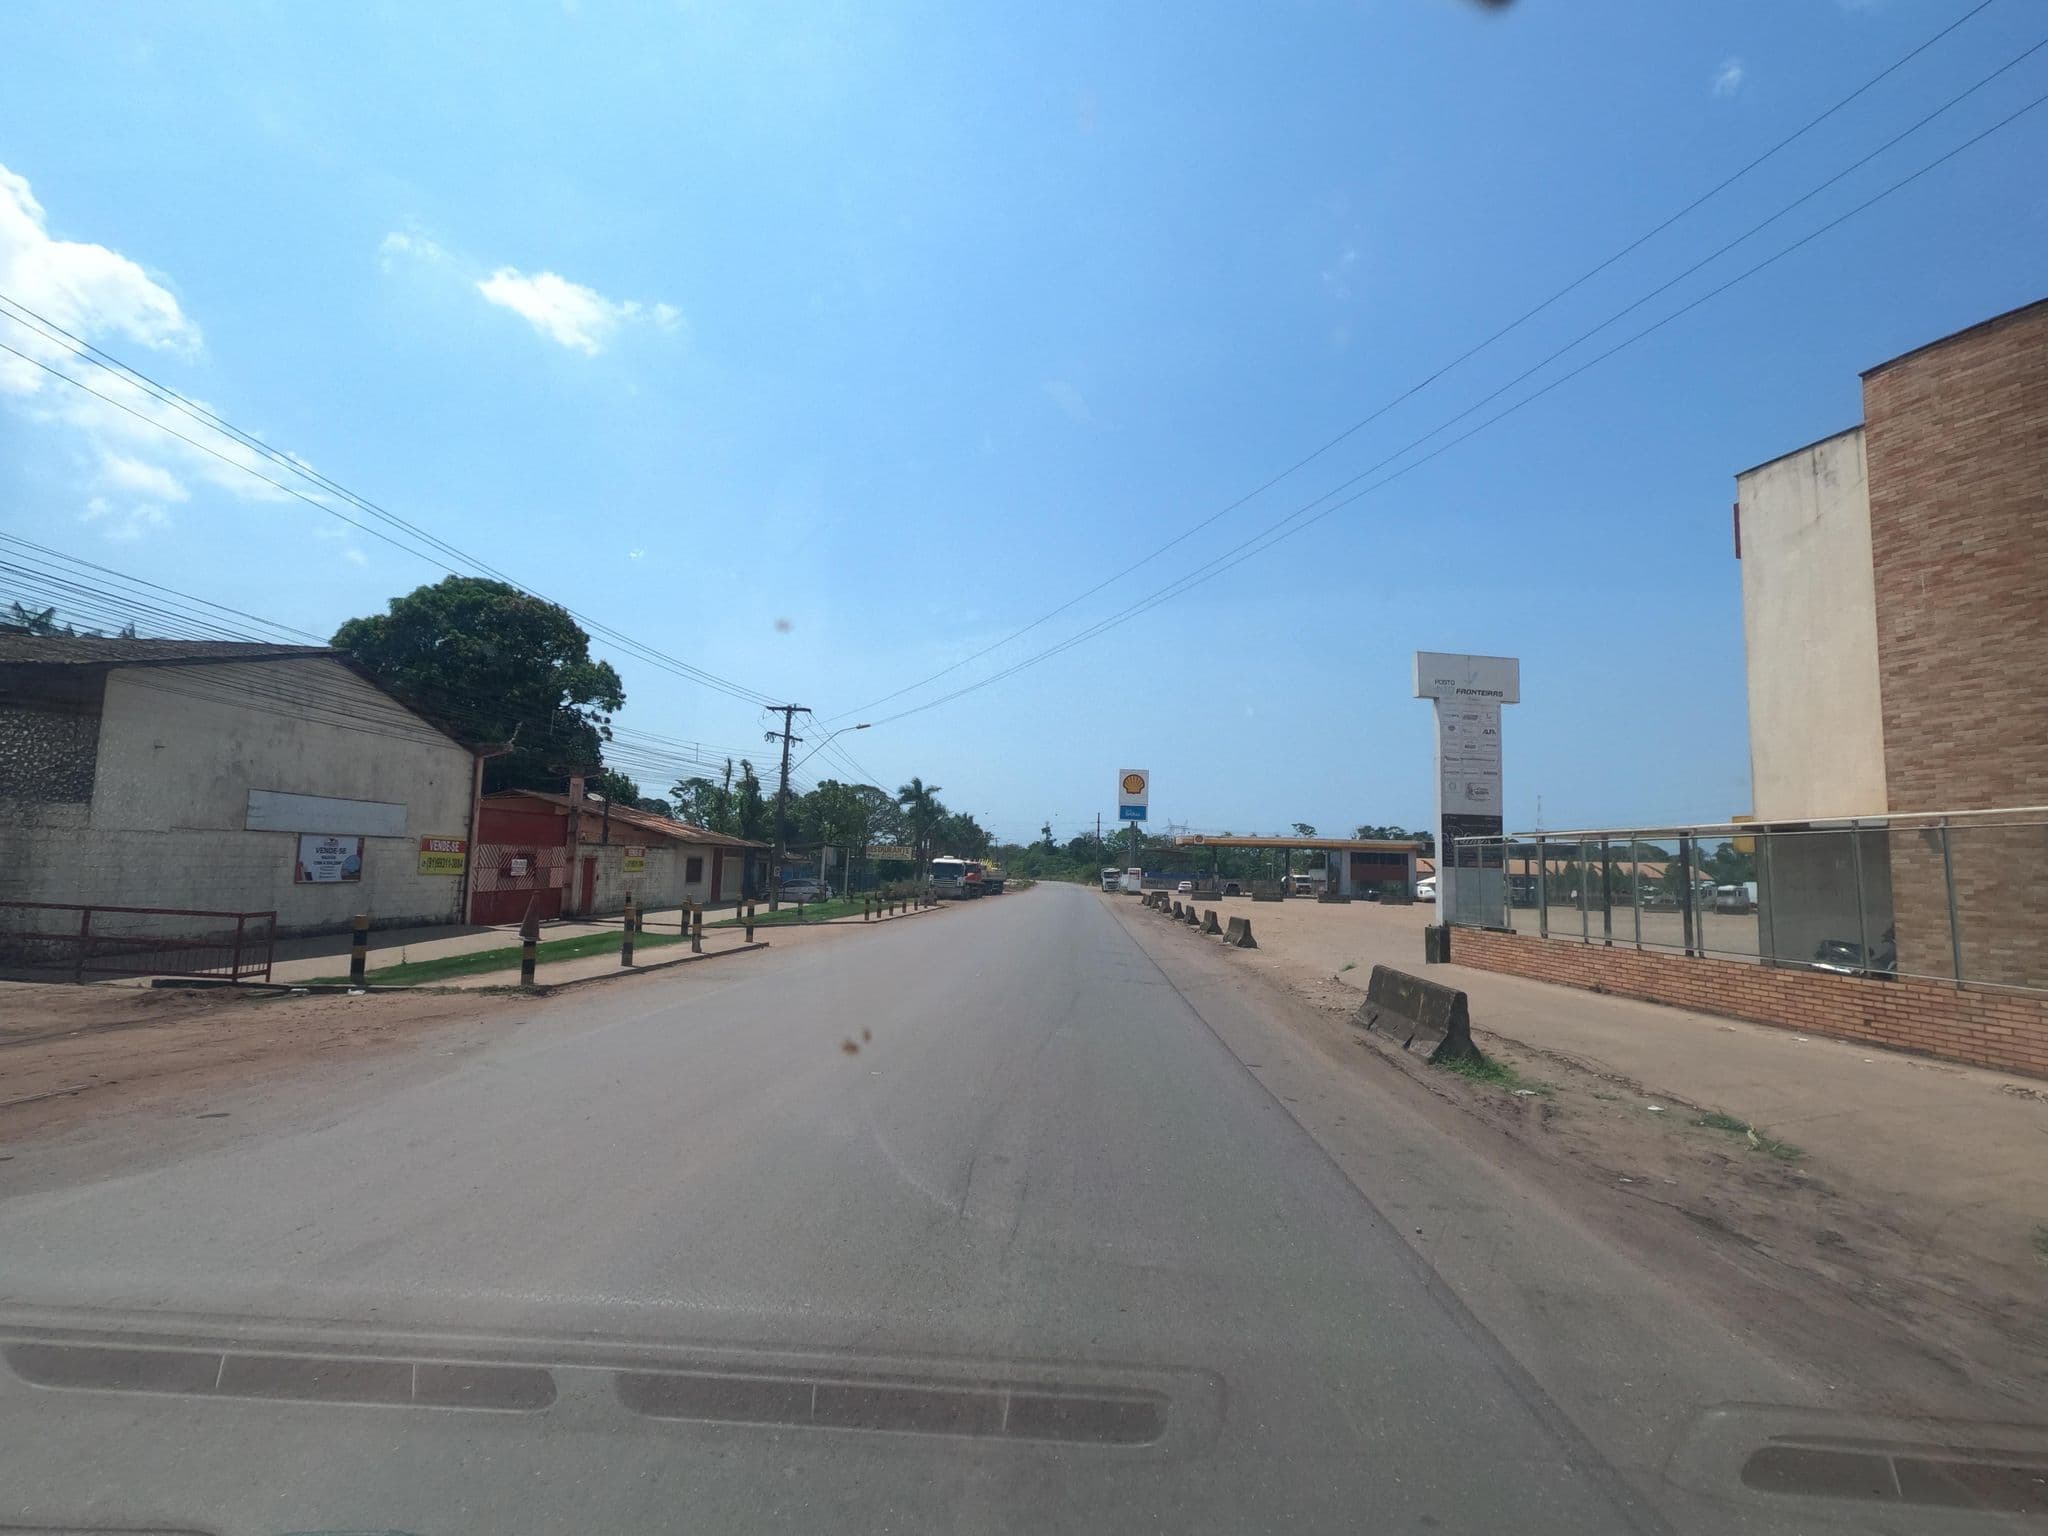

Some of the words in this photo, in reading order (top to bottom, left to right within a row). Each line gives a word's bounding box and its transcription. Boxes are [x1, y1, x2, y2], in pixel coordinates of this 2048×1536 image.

[1456, 688, 1504, 697] FRONTEIRAS
[430, 839, 460, 852] VENDE-SE
[315, 847, 347, 855] VENDE-SE
